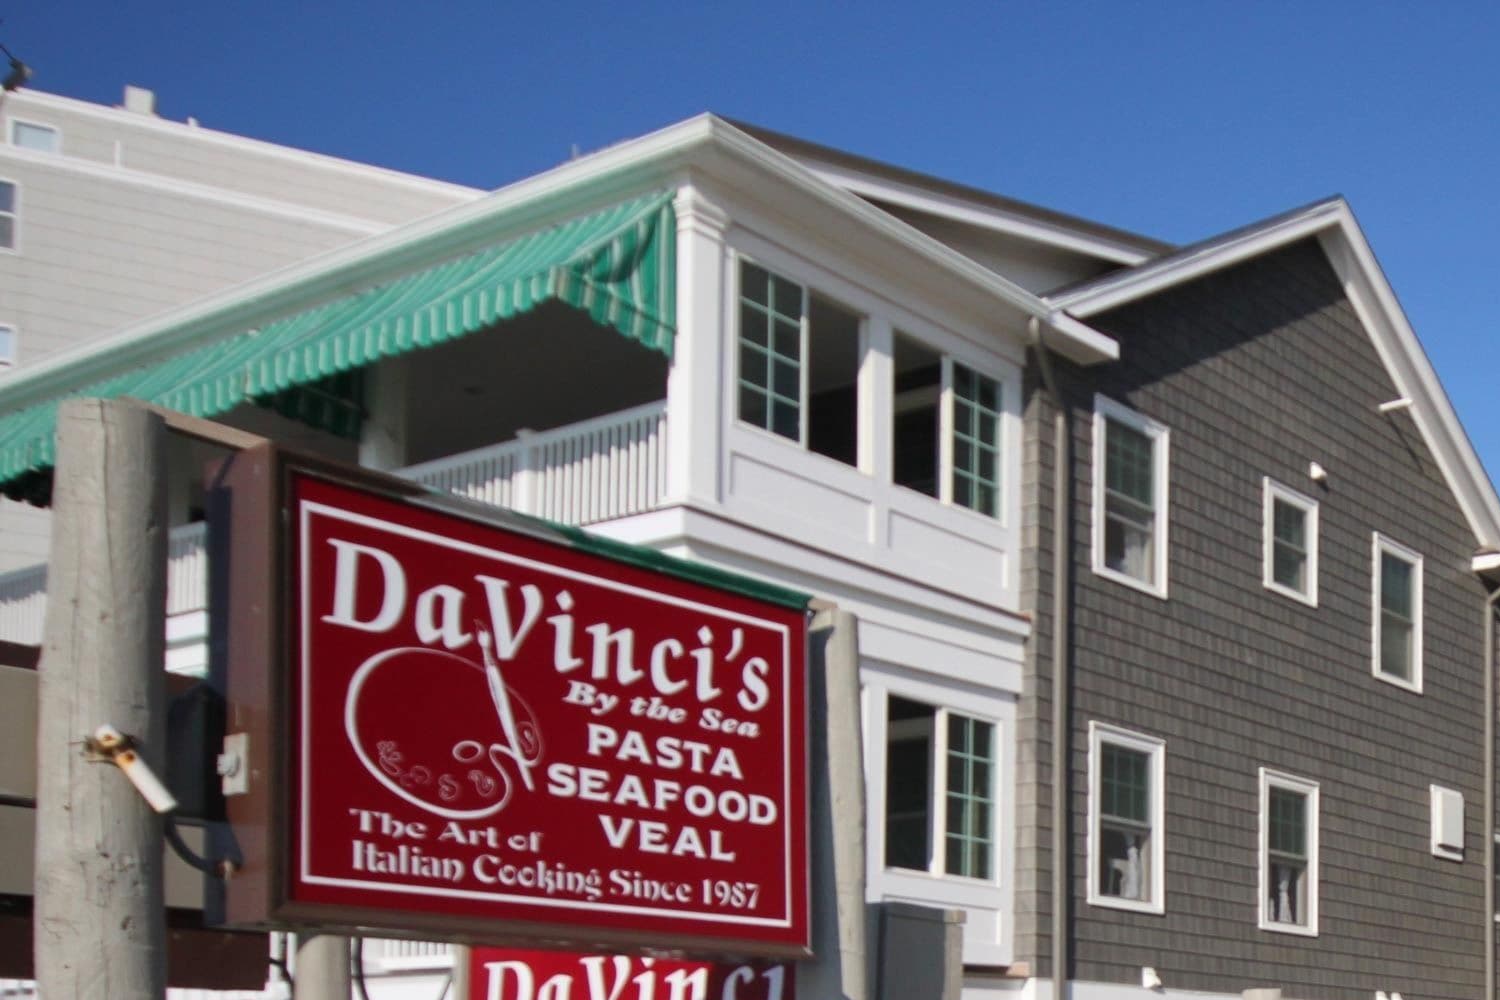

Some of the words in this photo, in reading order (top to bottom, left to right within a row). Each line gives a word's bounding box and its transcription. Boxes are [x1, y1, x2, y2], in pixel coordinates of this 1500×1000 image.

[320, 537, 770, 712] DaVinci's
[563, 679, 619, 715] By
[629, 696, 687, 724] the
[699, 707, 761, 738] Sea
[587, 723, 743, 779] PASTA
[547, 762, 778, 826] SEAFOOD
[349, 808, 428, 839] The
[437, 821, 498, 850] Art
[507, 830, 543, 853] of
[599, 814, 736, 862] VEAL
[351, 840, 465, 882] Italian
[472, 853, 602, 901] Cooking
[609, 867, 693, 904] Since
[702, 877, 760, 910] 1987
